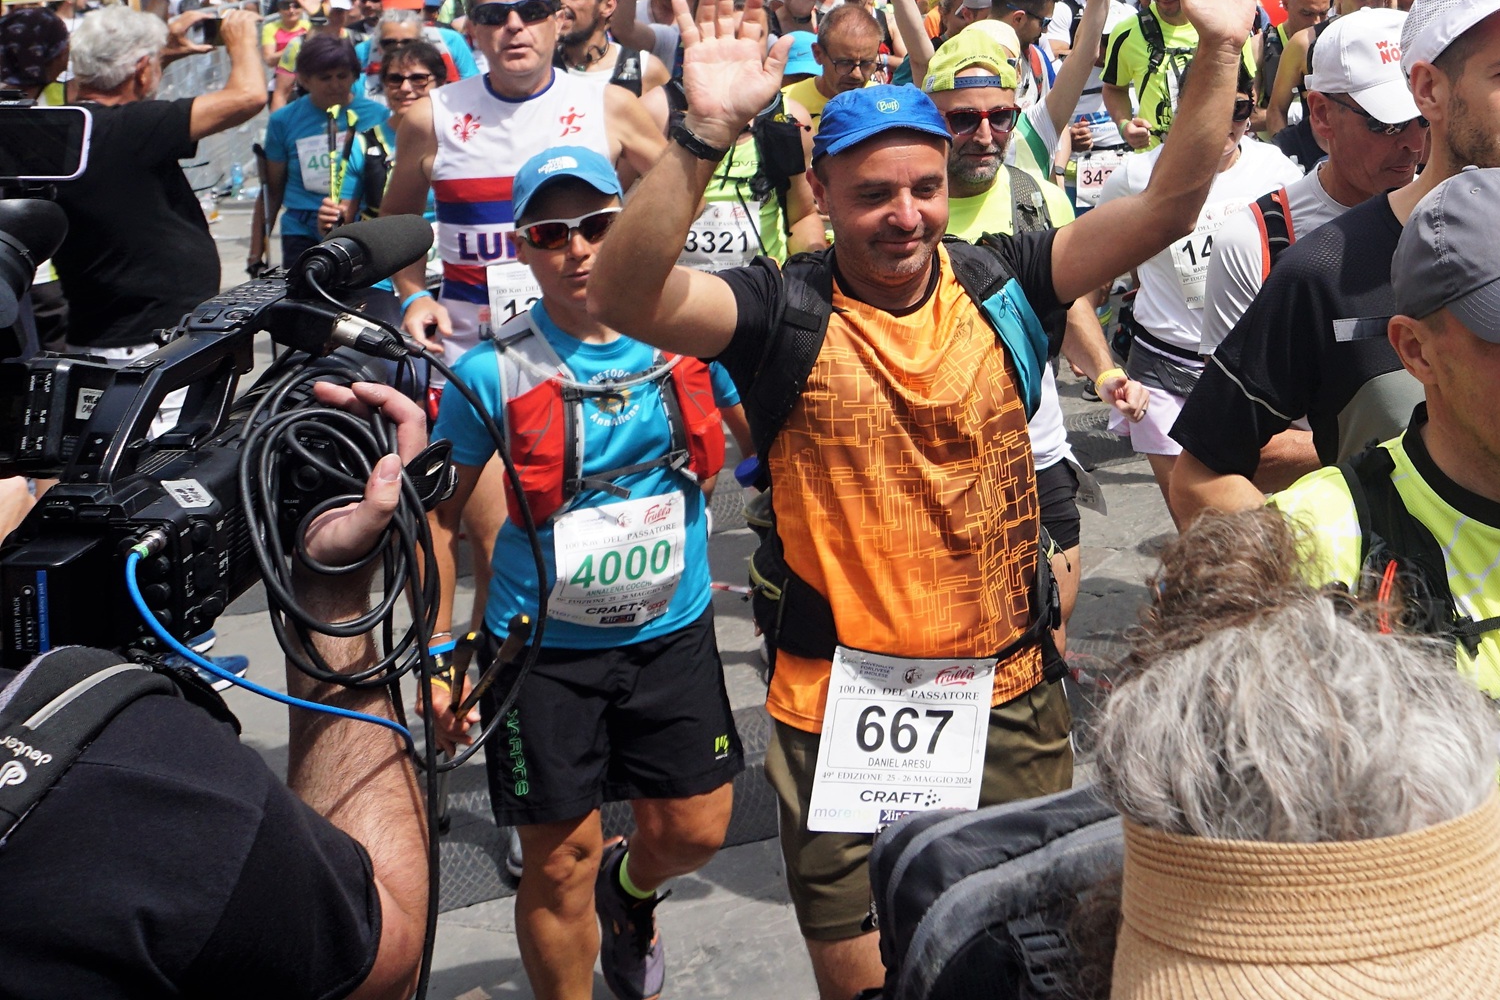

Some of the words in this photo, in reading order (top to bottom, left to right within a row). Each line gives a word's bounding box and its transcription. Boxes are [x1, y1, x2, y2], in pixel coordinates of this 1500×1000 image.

[879, 100, 899, 112] Buff
[683, 230, 748, 254] 3321
[603, 534, 623, 544] DEL
[626, 522, 677, 541] PASSATORE
[569, 539, 672, 590] 4000
[586, 584, 625, 597] ANNALENA
[13, 596, 21, 616] PACK
[585, 602, 638, 616] CRAFT
[14, 618, 22, 650] BATTERY
[860, 666, 891, 675] FORLIVESE
[864, 671, 890, 679] IMOLESE
[838, 685, 856, 695] 100
[858, 686, 877, 696] Km
[881, 687, 905, 697] DEL
[910, 689, 980, 701] PASSATORE
[856, 705, 954, 755] 667
[867, 757, 900, 768] DANIEL
[901, 758, 932, 770] ARESU
[837, 771, 883, 782] EDIZIONE
[886, 773, 896, 782] 25
[902, 774, 912, 783] 26
[913, 775, 954, 785] MAGGIO
[955, 776, 972, 785] 2024
[859, 789, 925, 805] CRAFT
